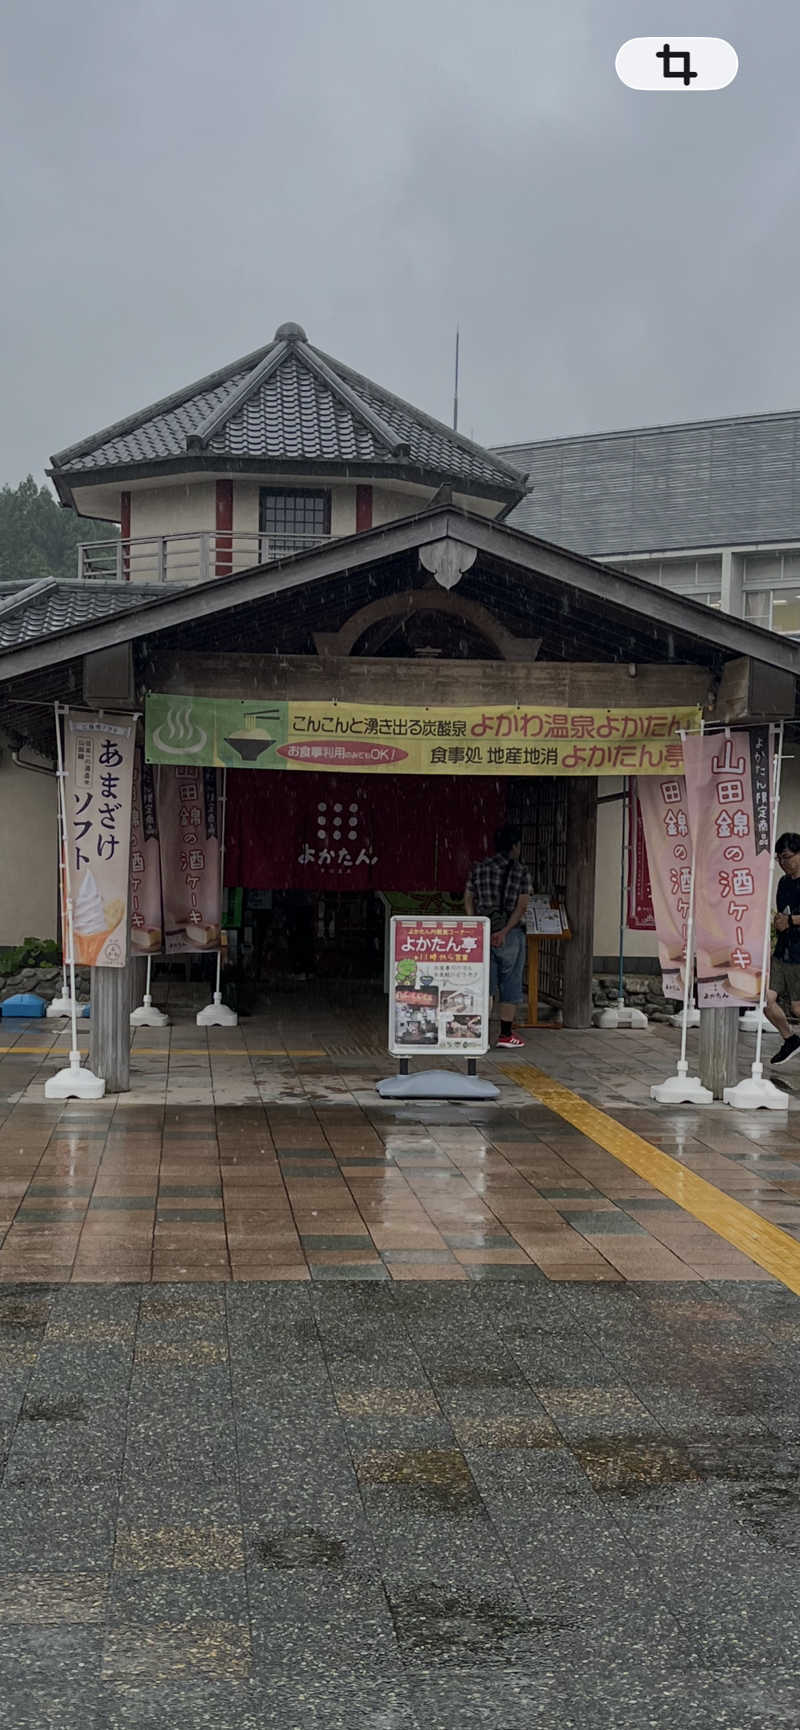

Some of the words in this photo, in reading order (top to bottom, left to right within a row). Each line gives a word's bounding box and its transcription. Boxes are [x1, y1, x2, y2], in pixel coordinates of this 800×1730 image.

[292, 715, 467, 737] こんこんと湧き出る炭酸泉
[431, 746, 482, 764] 食事処
[488, 748, 558, 765] 地産地消
[562, 745, 684, 769] よかたん亭
[97, 739, 124, 861] あまざけ
[73, 792, 93, 870] ソフト
[298, 843, 378, 866] よかたん
[711, 739, 755, 969] 山田錦の酒ケーキ
[401, 936, 478, 953] よかたん亭
